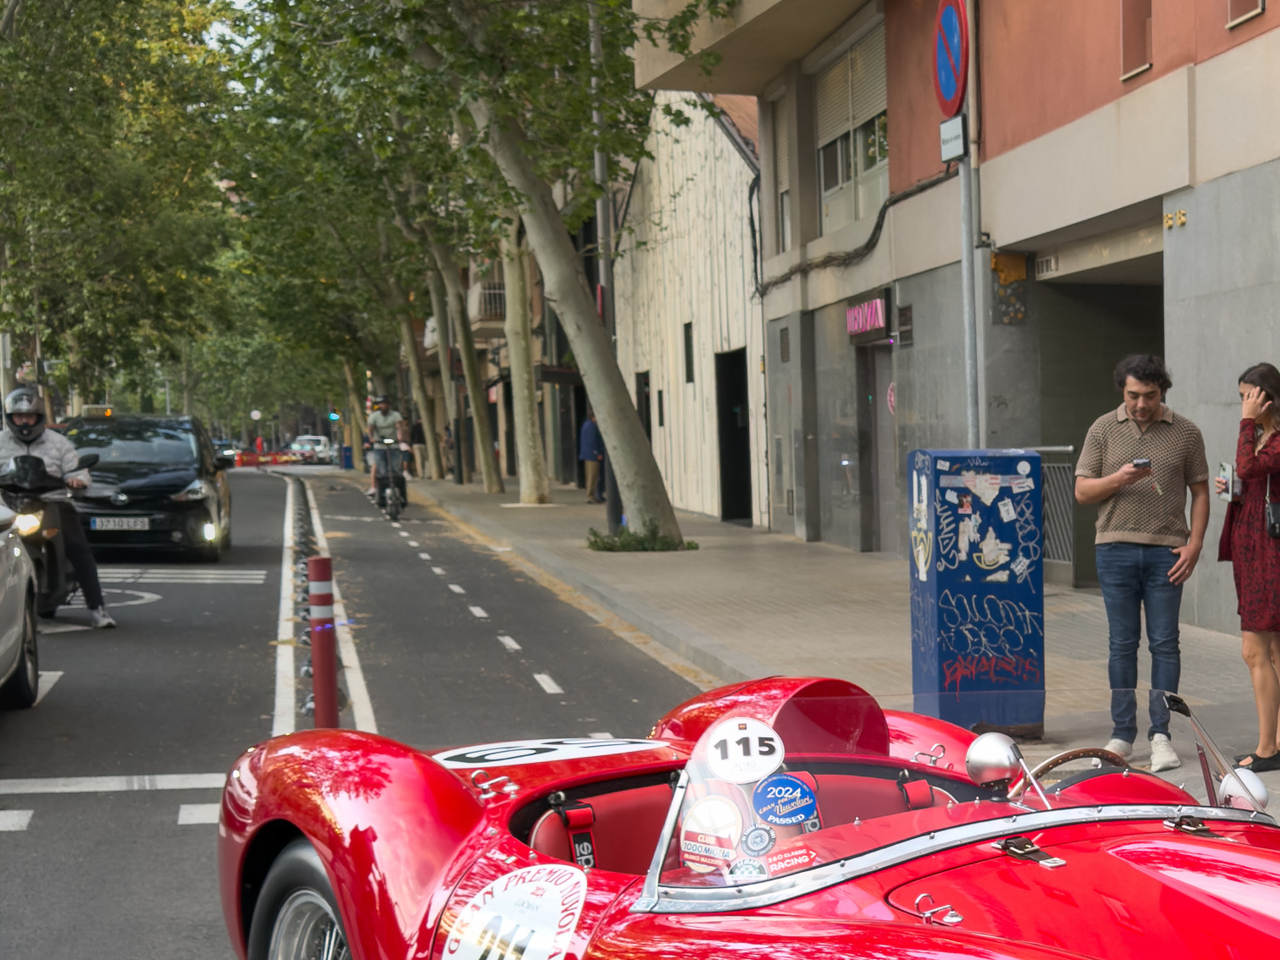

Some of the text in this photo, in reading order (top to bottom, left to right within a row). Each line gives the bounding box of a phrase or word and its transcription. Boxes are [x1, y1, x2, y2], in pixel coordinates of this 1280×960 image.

[713, 736, 776, 760] 115
[766, 786, 802, 799] 2024
[767, 813, 805, 824] PASSED
[697, 834, 716, 845] CLUB
[767, 849, 807, 863] 360 CLASSIC
[770, 855, 810, 872] RACING
[447, 886, 495, 955] GRAN
[503, 867, 574, 892] PREMIO
